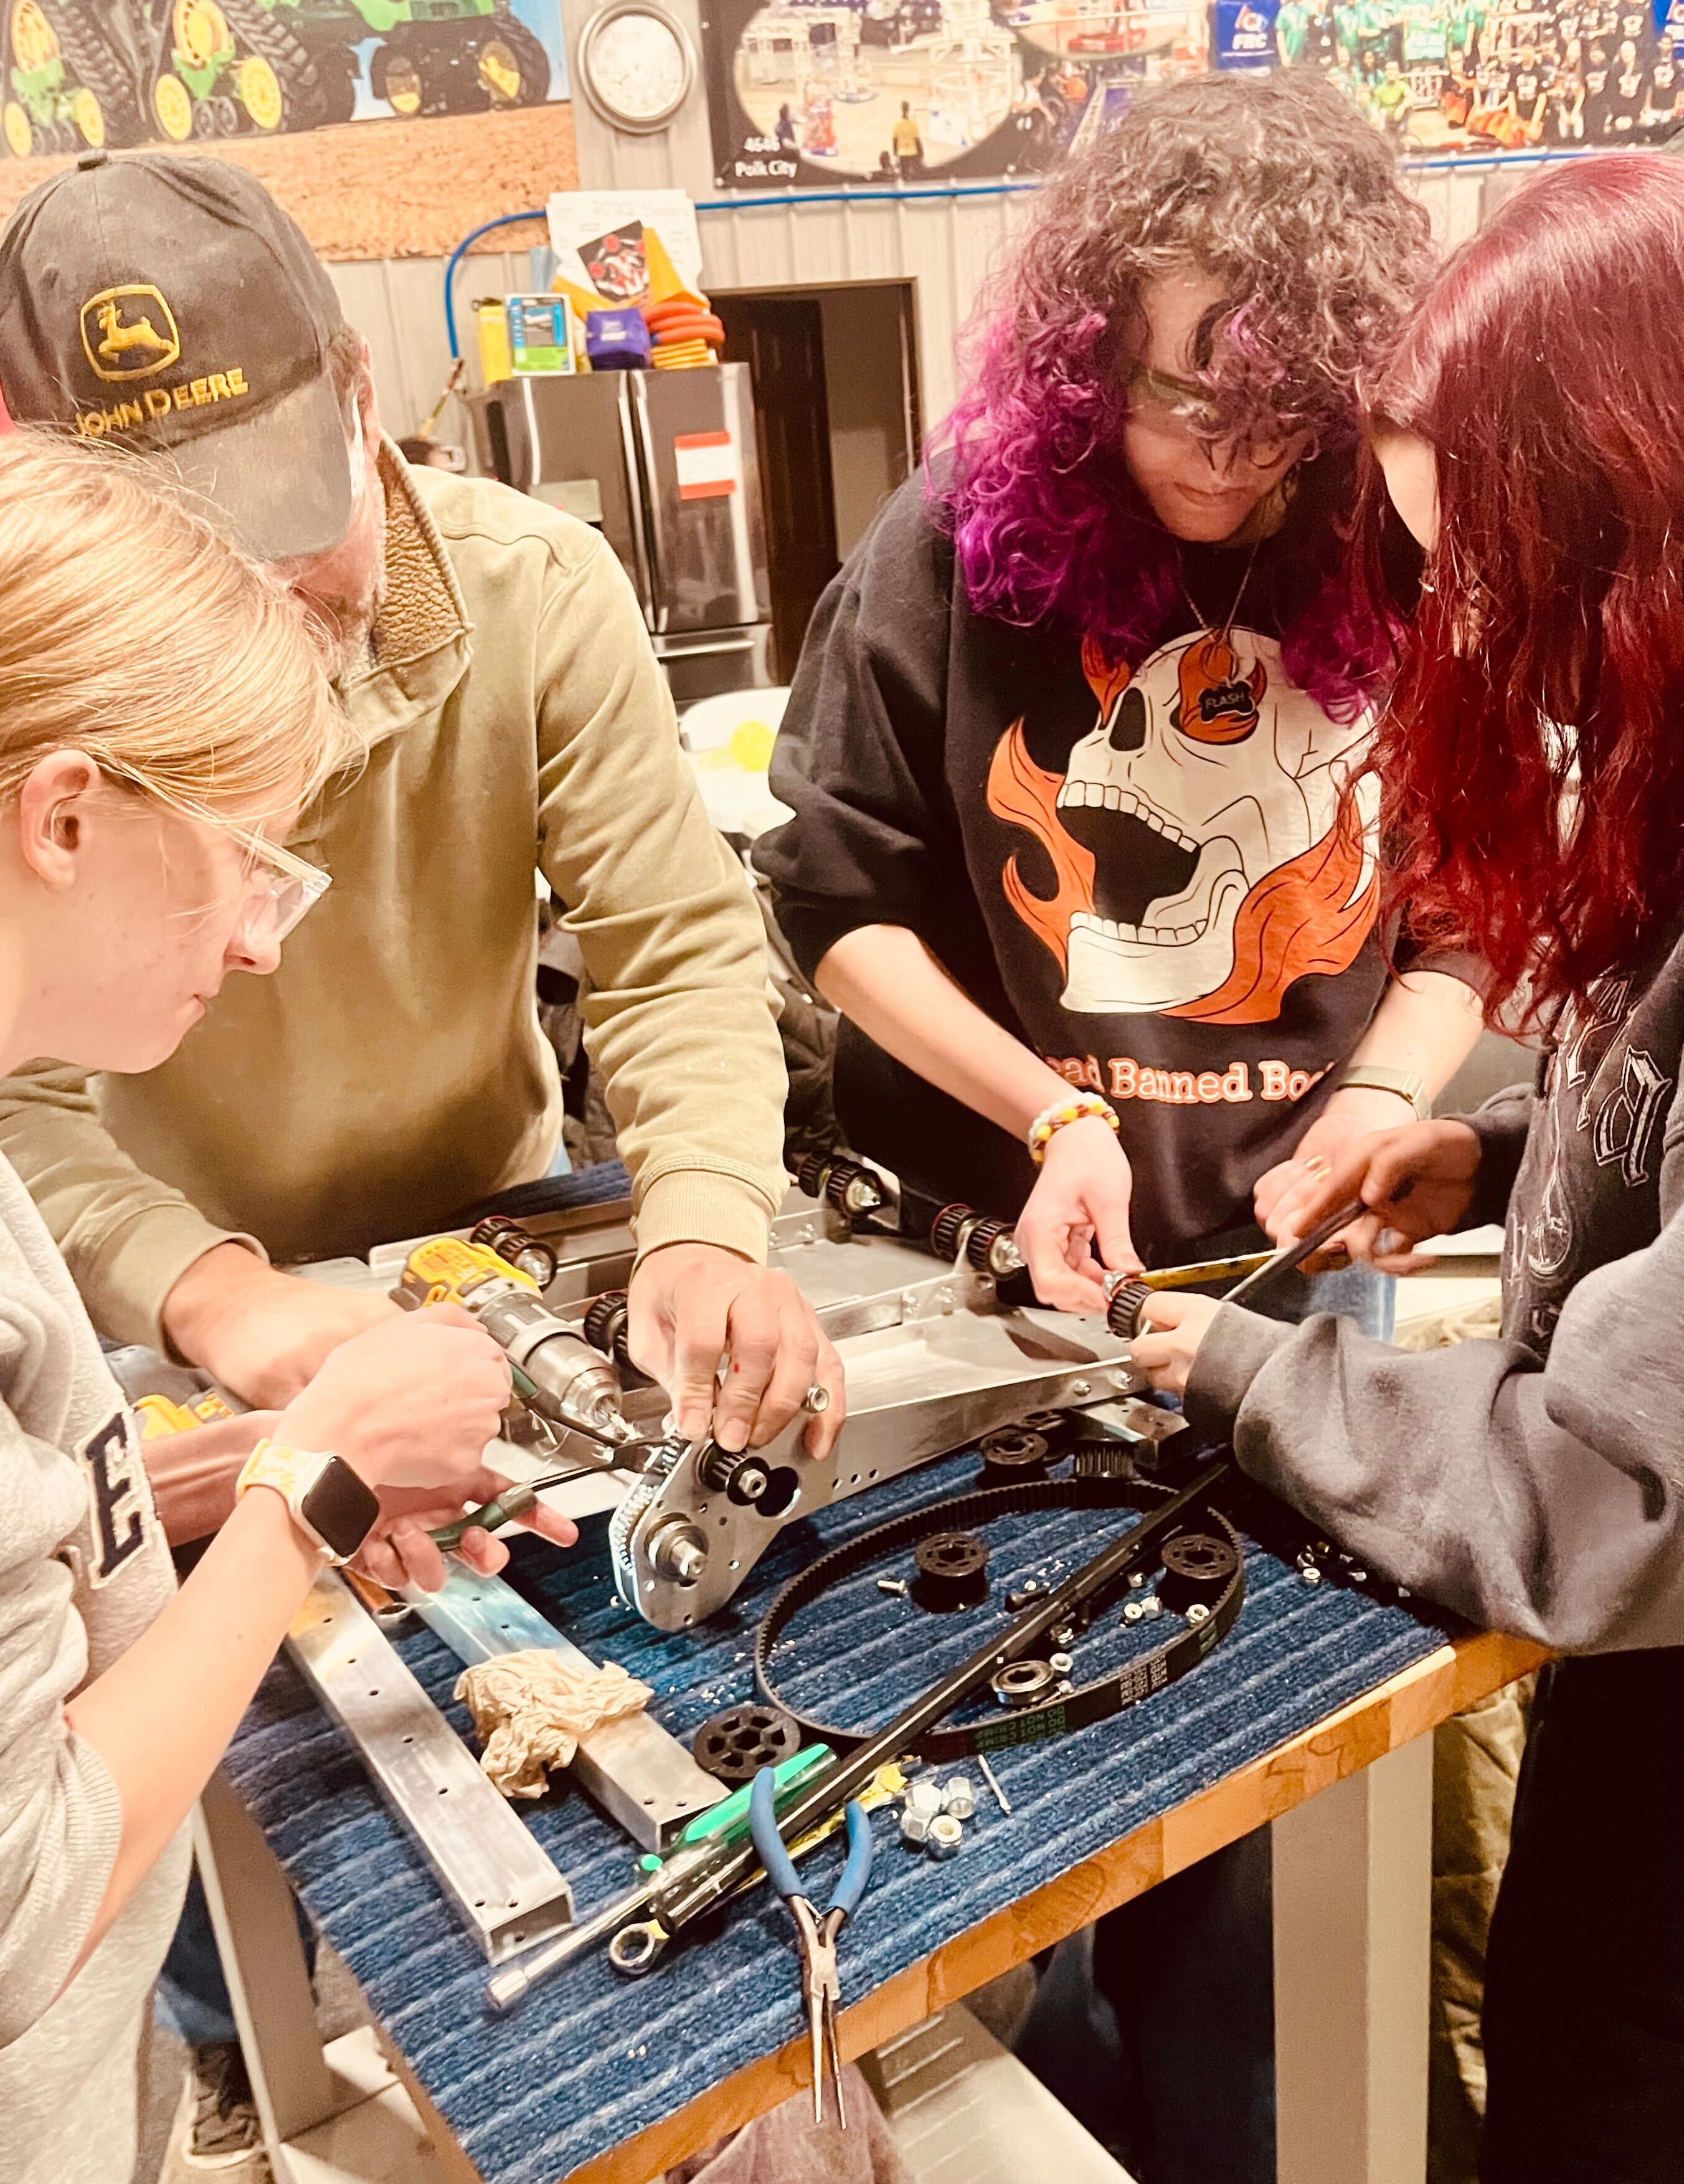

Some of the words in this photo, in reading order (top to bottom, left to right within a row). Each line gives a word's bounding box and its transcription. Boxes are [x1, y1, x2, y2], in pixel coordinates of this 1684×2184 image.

[735, 160, 767, 178] Polk
[768, 159, 798, 179] City
[143, 368, 248, 418] DEERE
[1205, 692, 1245, 710] FLASH
[1107, 1057, 1254, 1104] Banned
